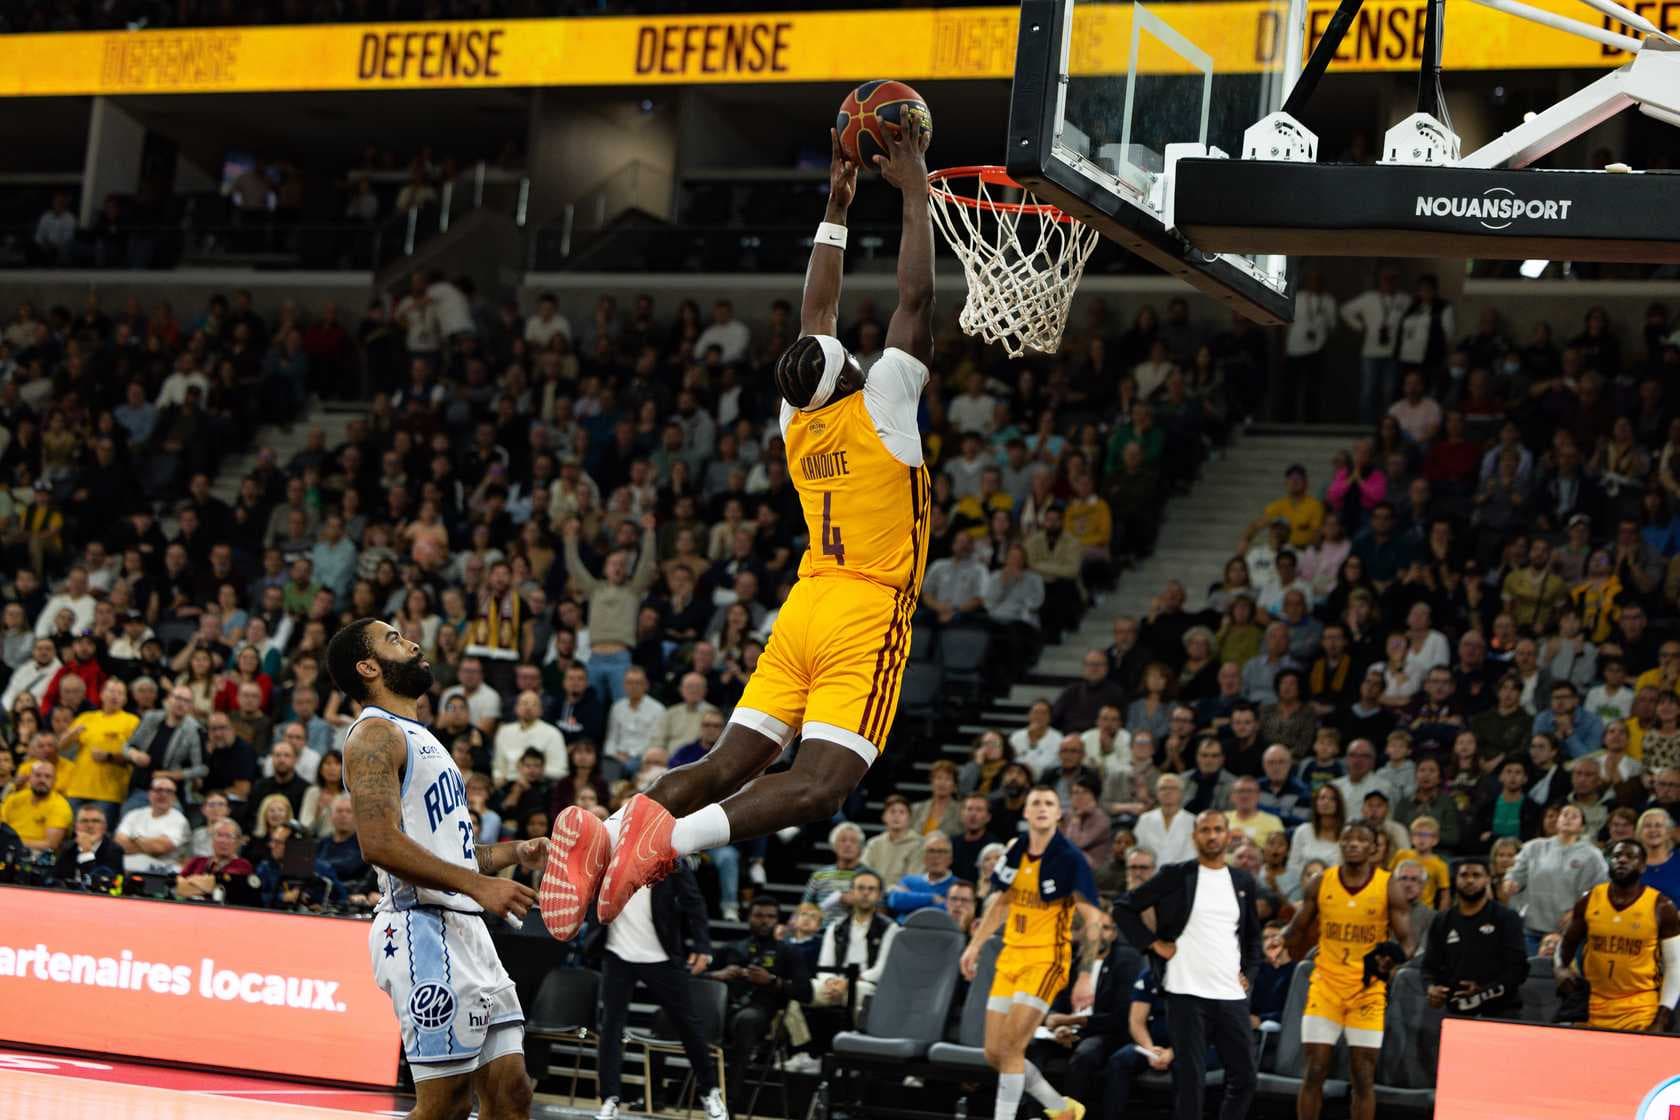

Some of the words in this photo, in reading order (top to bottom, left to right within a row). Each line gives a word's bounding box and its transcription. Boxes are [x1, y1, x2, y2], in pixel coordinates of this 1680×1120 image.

[102, 34, 241, 86] DEFENSE
[358, 29, 505, 79] DEFENSE
[635, 22, 793, 75] DEFENSE
[1254, 7, 1428, 64] DFNSE
[1415, 196, 1572, 220] NOUANSPORT
[800, 450, 850, 481] KANOUTE
[822, 490, 845, 566] 4
[0, 943, 192, 996] artenaires
[199, 957, 346, 1012] locaux.
